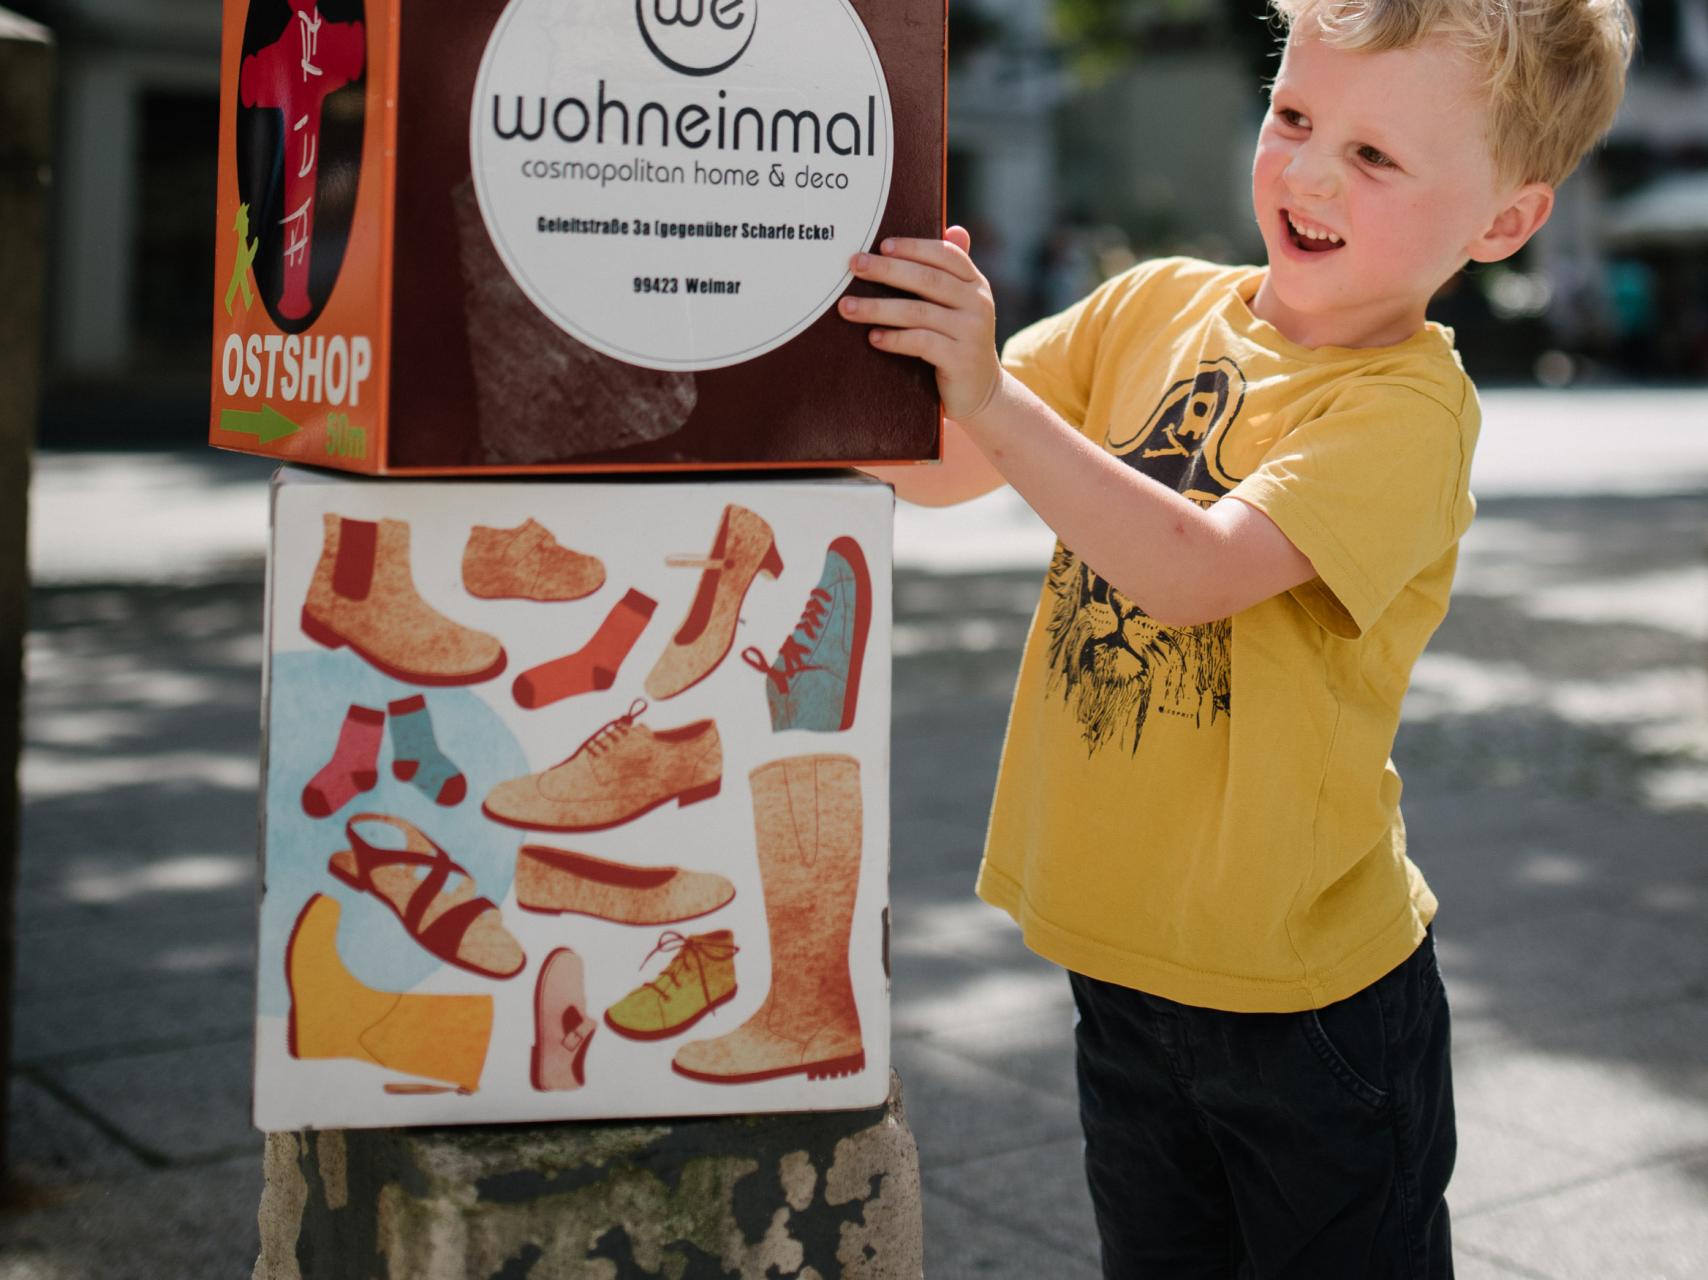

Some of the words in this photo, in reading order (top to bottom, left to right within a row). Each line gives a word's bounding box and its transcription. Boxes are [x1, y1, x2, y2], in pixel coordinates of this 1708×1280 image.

[492, 79, 876, 157] wohneinmal
[521, 157, 685, 188] cosmopolitan
[694, 160, 760, 187] home
[769, 163, 785, 188] &
[795, 164, 849, 190] deco
[537, 216, 629, 234] Geleitstraße
[633, 219, 651, 236] 3a
[741, 223, 795, 240] Scharfe
[633, 277, 678, 294] 99423
[685, 277, 741, 295] Weimar
[222, 333, 372, 407] OSTSHOP
